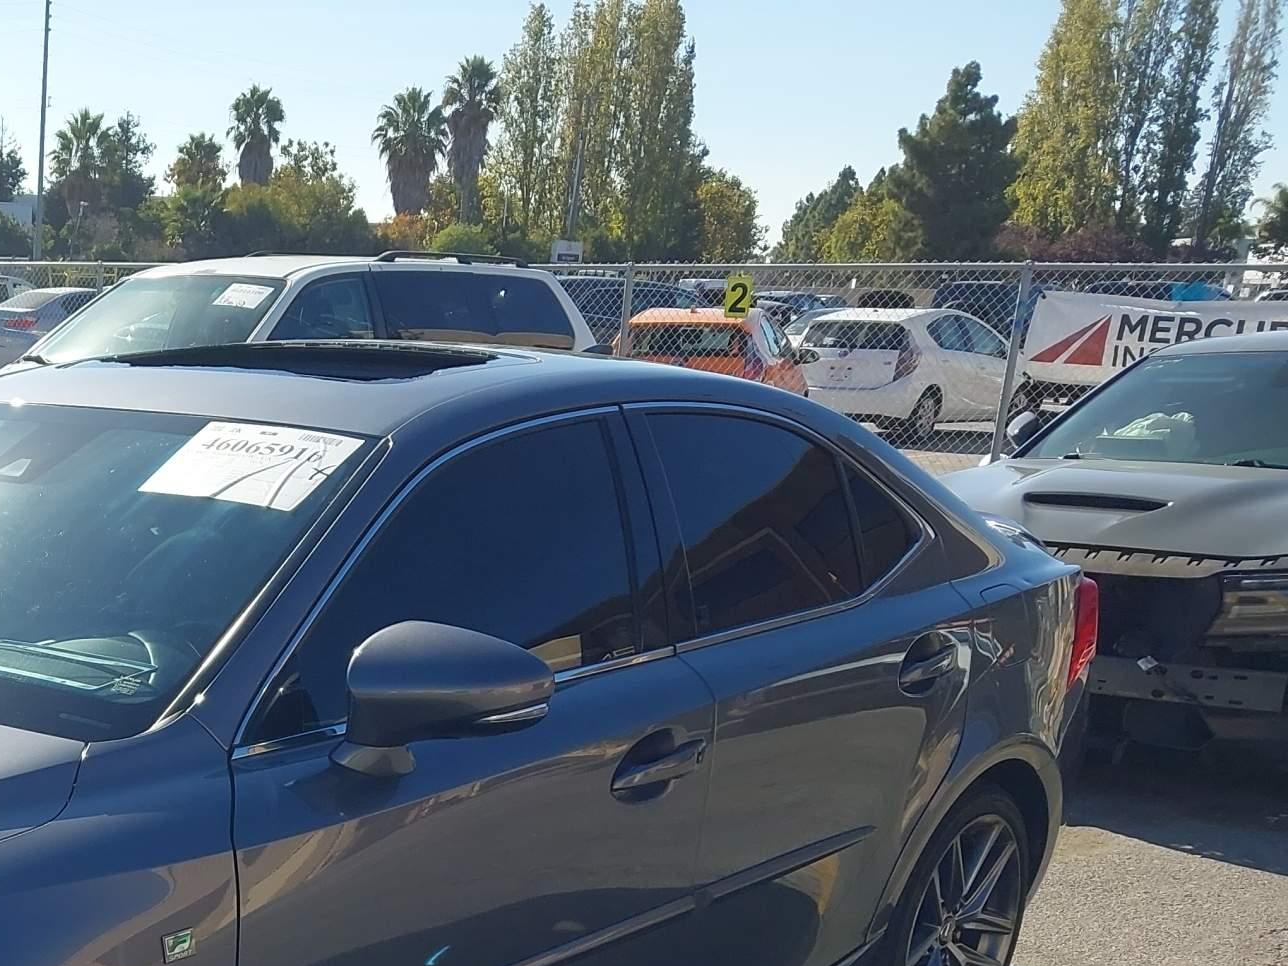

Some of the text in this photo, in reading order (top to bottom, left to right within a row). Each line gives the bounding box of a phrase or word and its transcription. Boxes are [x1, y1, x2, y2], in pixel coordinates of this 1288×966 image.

[728, 282, 749, 313] 2
[1112, 345, 1160, 367] IN
[201, 437, 322, 463] 46065916
